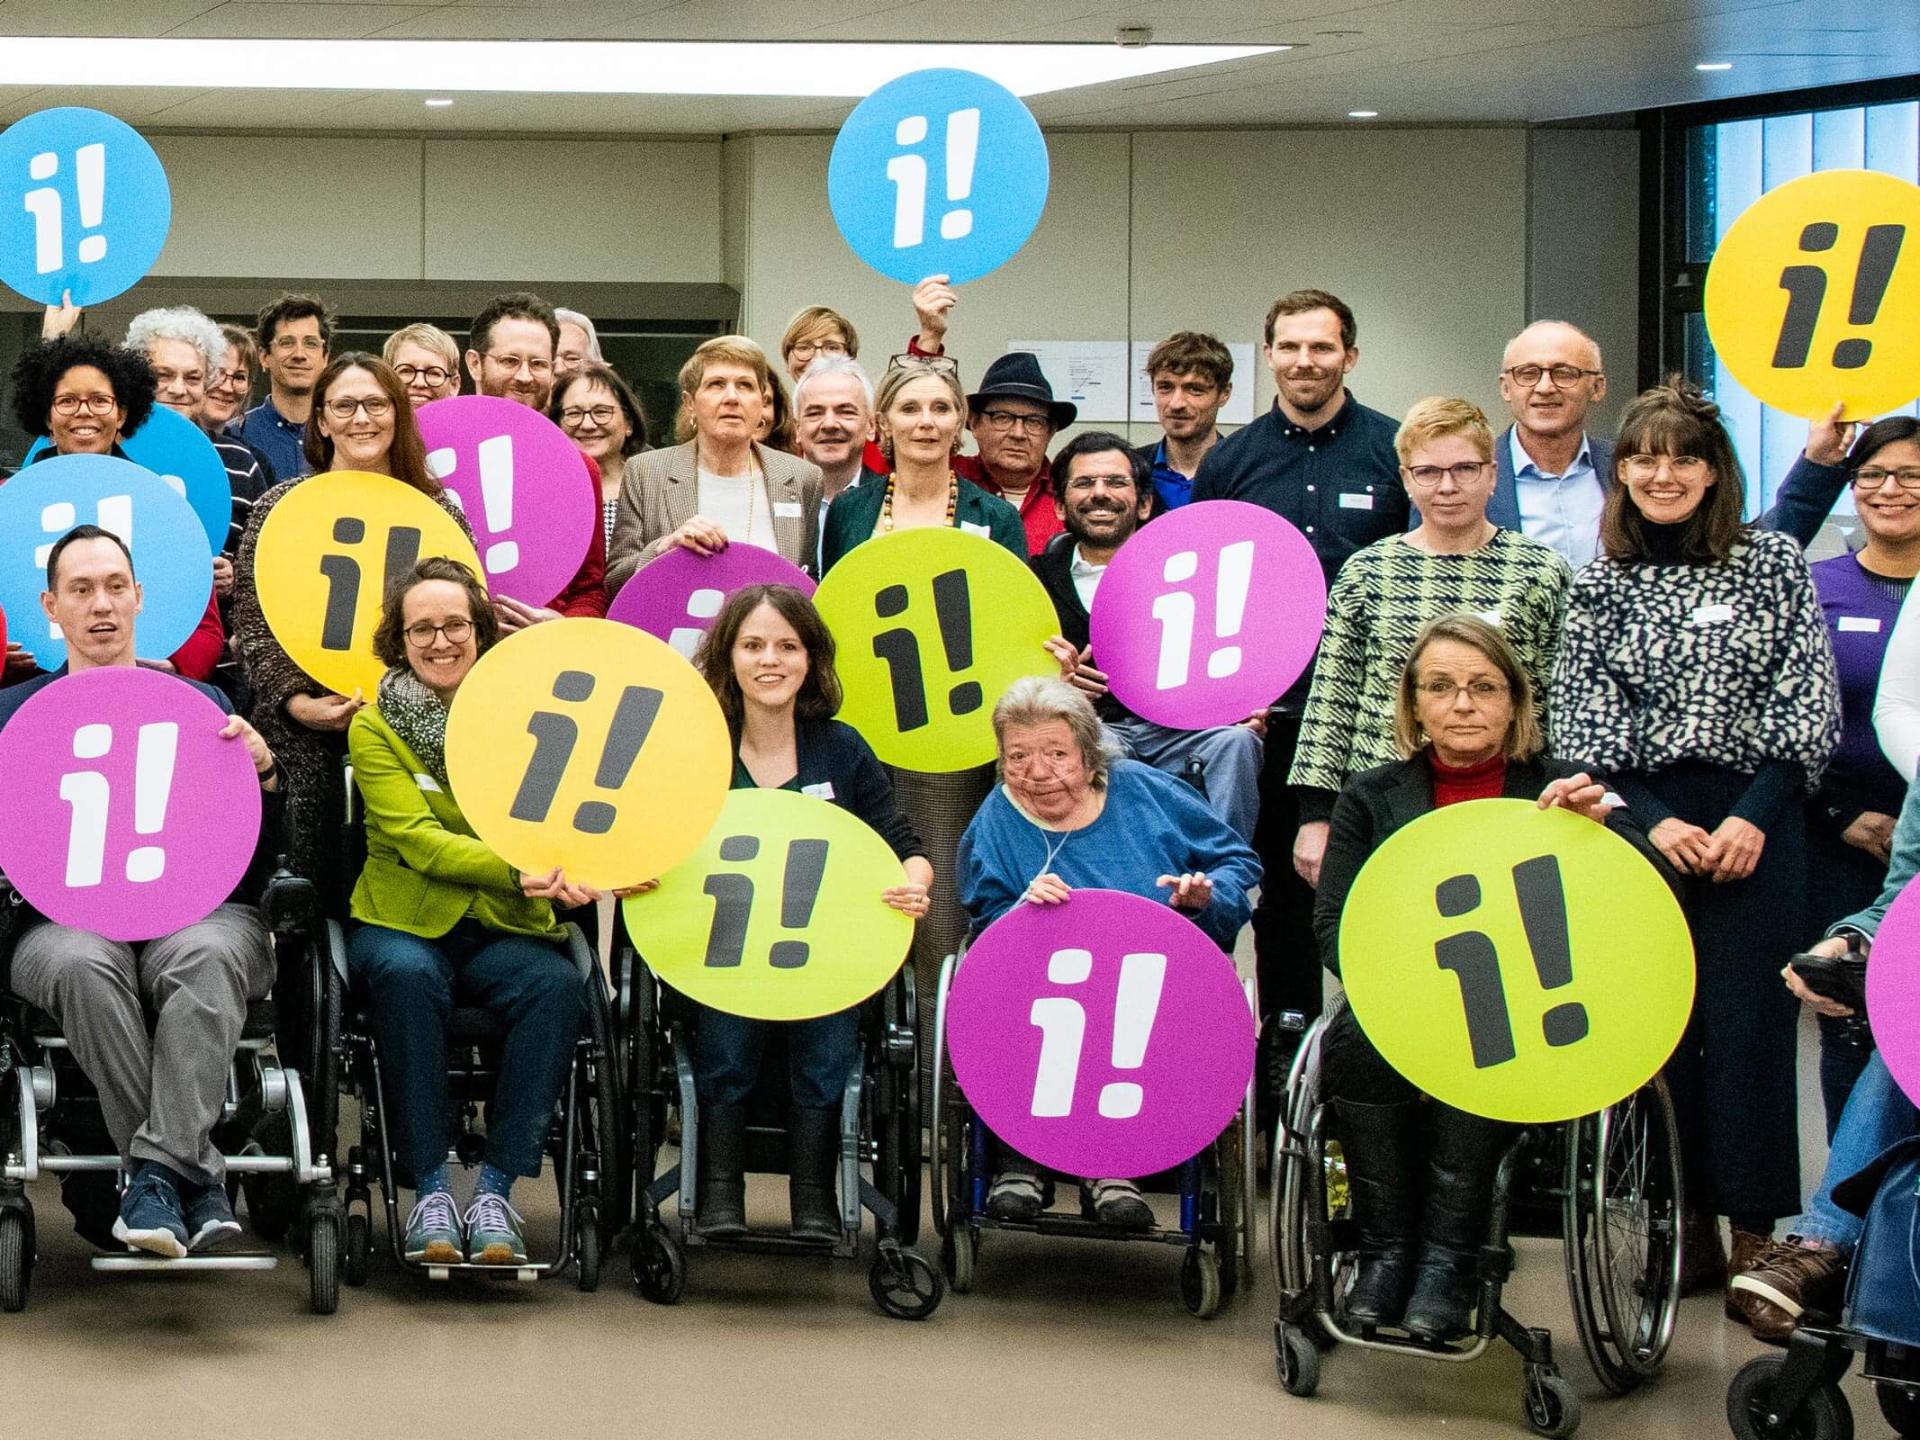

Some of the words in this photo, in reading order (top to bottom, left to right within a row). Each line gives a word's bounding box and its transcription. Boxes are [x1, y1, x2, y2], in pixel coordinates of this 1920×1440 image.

[24, 143, 107, 274] i!
[888, 108, 980, 248] i!
[1772, 222, 1906, 369] i!
[872, 568, 983, 733] i!
[1151, 540, 1256, 691] i!
[59, 721, 179, 888] i!
[509, 670, 664, 834] i!
[703, 835, 830, 970] i!
[1435, 854, 1589, 1070] i!
[1031, 949, 1167, 1119] i!
